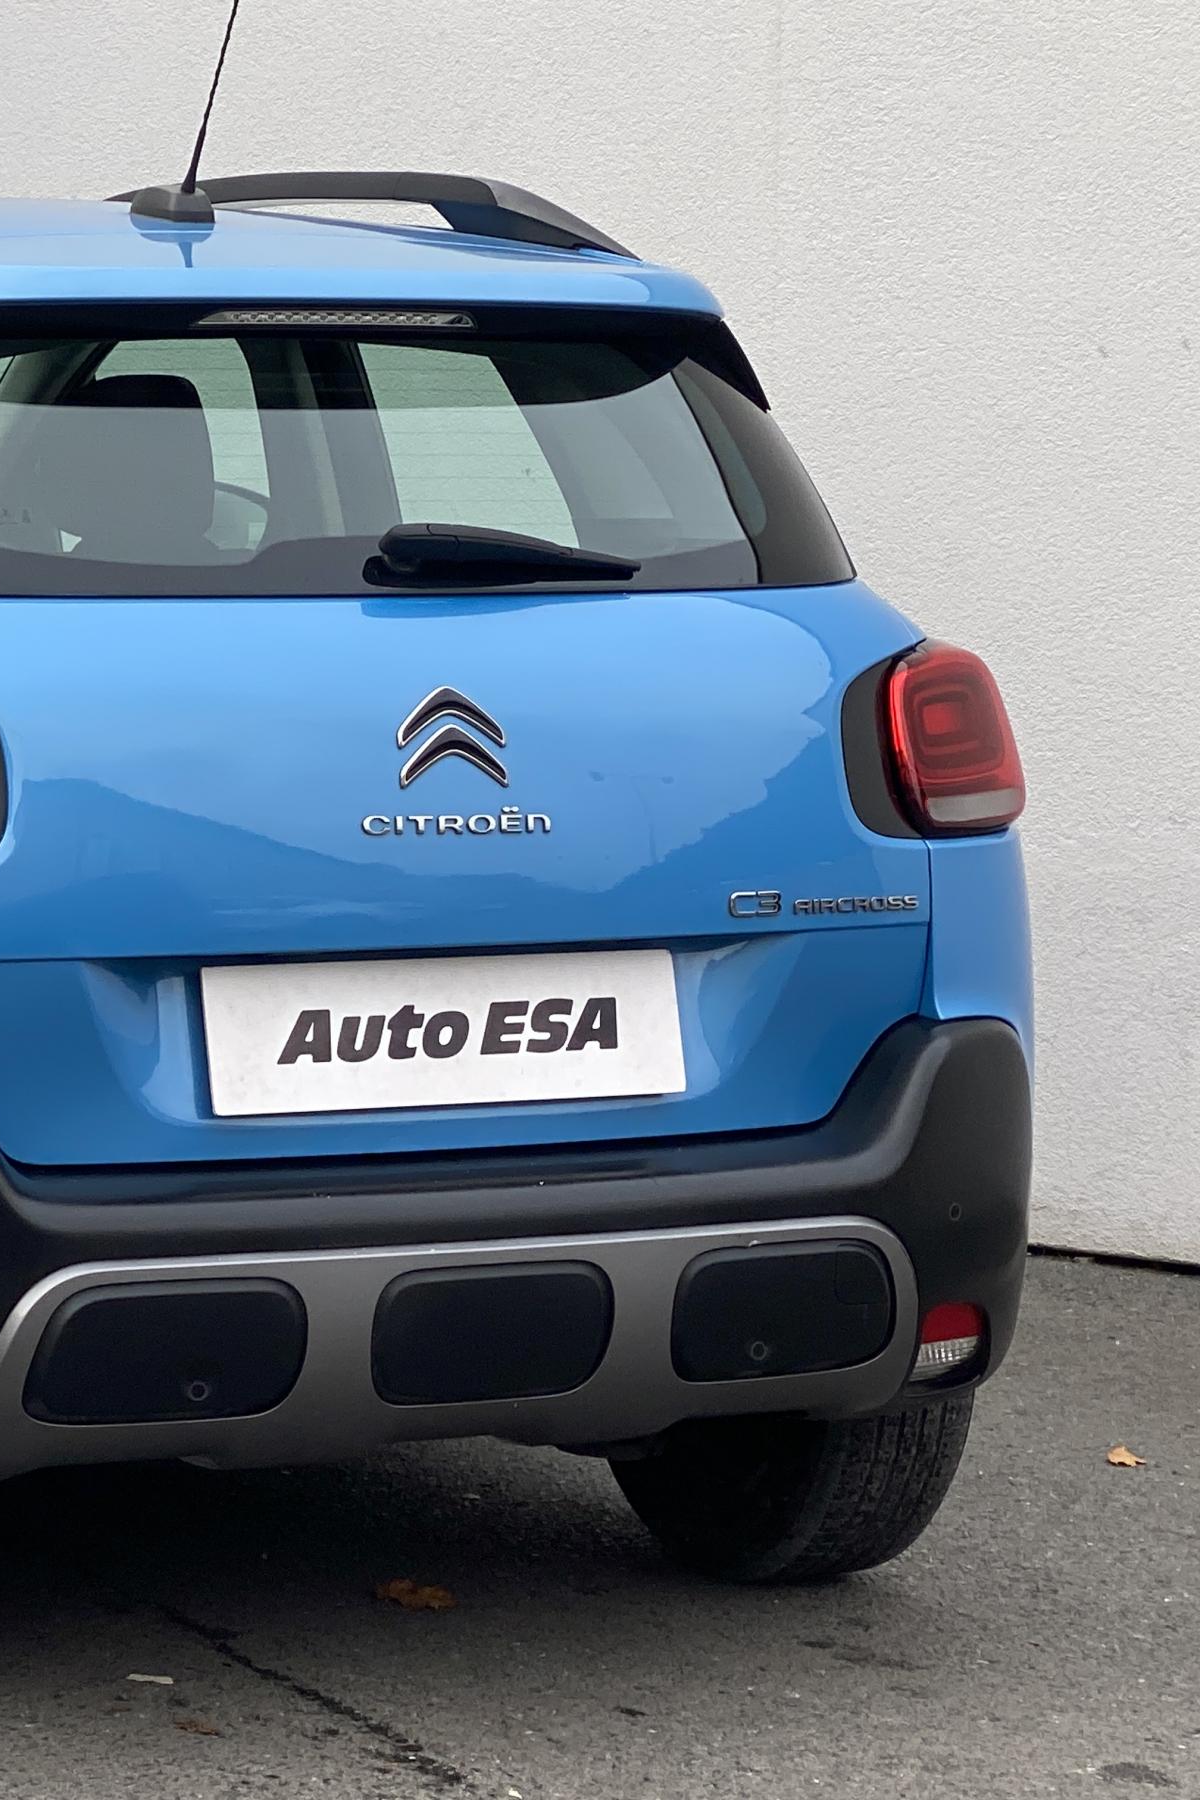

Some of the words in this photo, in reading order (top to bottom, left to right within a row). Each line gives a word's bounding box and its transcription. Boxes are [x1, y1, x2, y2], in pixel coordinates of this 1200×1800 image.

[729, 890, 782, 918] C3
[794, 895, 919, 915] AIRCROSS
[277, 1004, 470, 1065] Auto
[480, 997, 618, 1056] ESA
